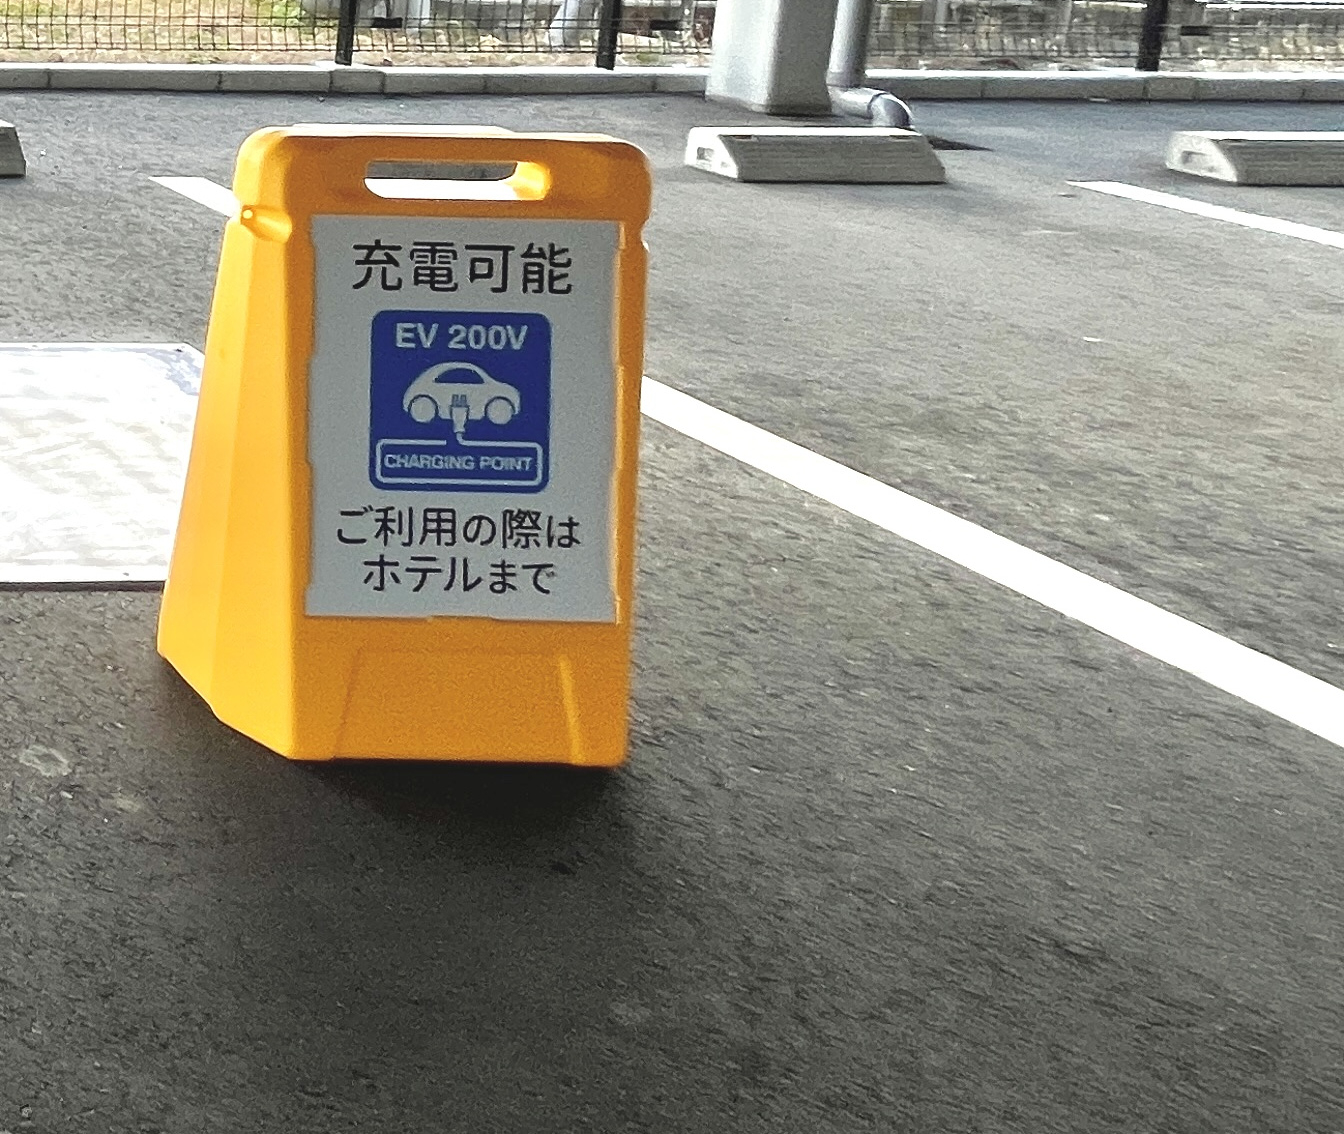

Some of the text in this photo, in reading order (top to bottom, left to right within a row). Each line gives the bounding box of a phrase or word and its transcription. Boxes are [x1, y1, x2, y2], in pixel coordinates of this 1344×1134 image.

[352, 239, 574, 295] 充電可能
[395, 322, 529, 352] EV 200V
[383, 452, 533, 472] CHARGING POINT
[336, 505, 582, 549] ご利用の際は
[363, 554, 558, 595] ホテルまで
